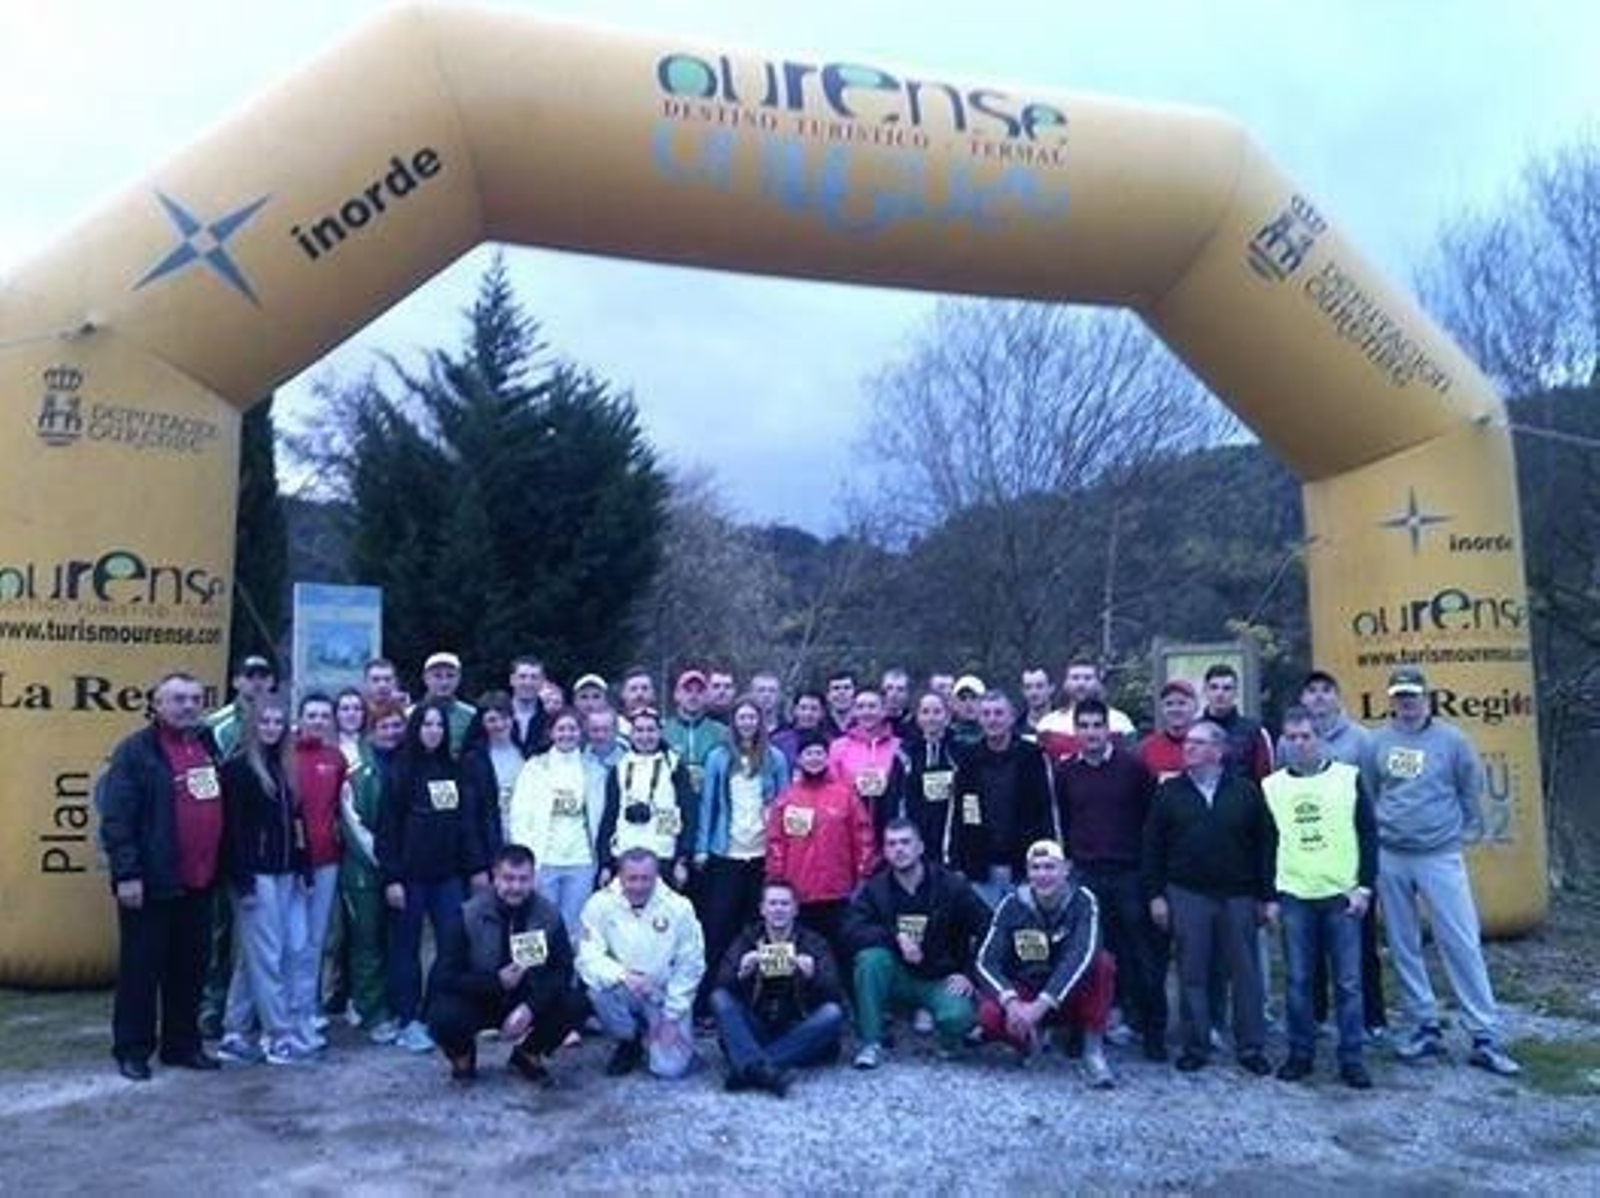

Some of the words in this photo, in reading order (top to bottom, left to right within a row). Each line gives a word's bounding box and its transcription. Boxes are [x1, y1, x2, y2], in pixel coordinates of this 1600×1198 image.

[657, 53, 1067, 140] ourense
[663, 99, 778, 130] DESTINO
[971, 141, 1068, 168] TERMAL
[290, 147, 442, 261] inorde
[41, 771, 91, 875] Plan
